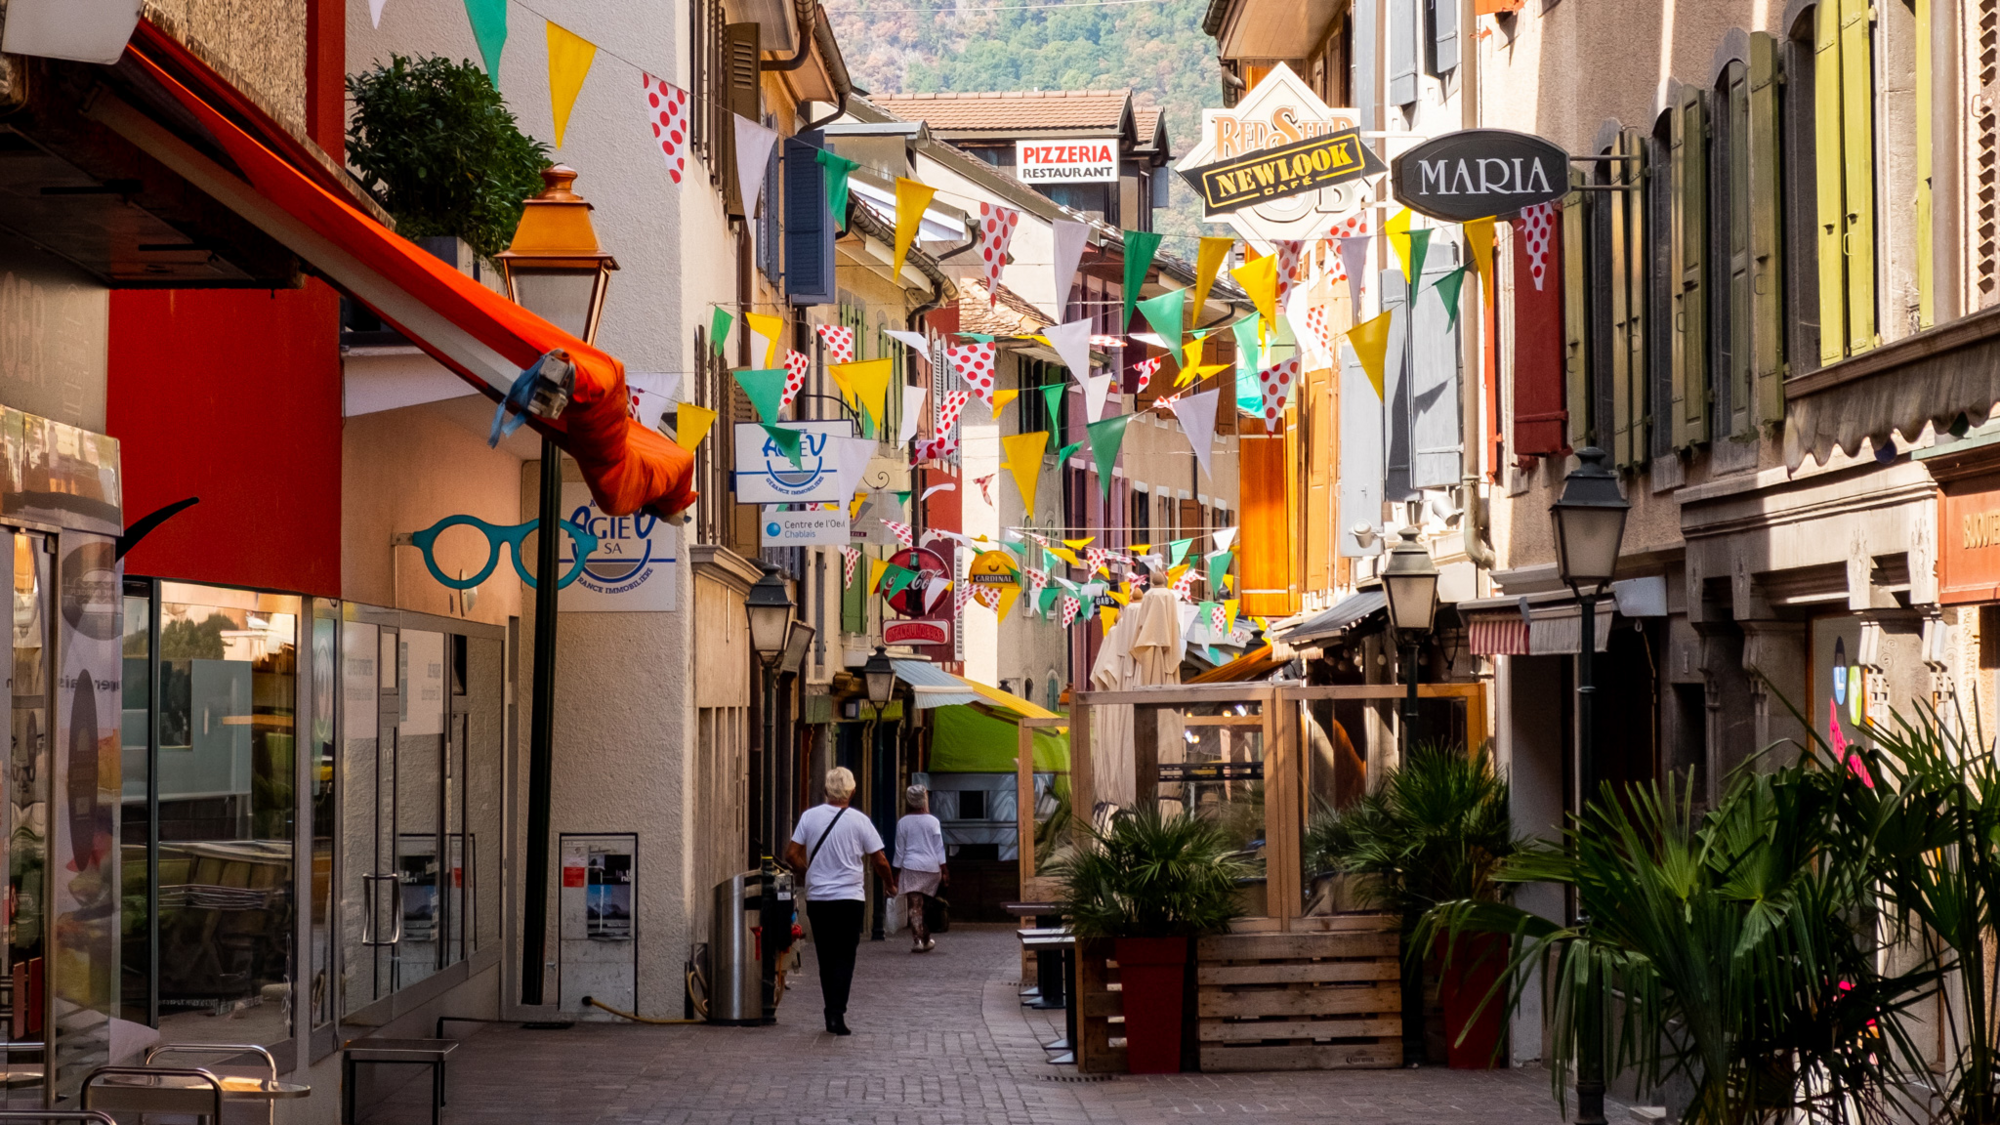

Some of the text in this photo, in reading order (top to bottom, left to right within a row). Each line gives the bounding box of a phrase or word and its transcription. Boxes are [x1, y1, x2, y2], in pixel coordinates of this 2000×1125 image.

[1023, 145, 1113, 164] PIZZERIA
[1023, 167, 1113, 178] RESTAURANT
[1215, 142, 1354, 198] NEWLOOK
[1418, 156, 1554, 195] MARIA
[1263, 176, 1313, 196] CAFÉ
[784, 520, 813, 529] Centre
[814, 520, 824, 528] de
[784, 530, 816, 538] Chablais
[604, 542, 622, 554] SA
[577, 577, 603, 593] RANCE
